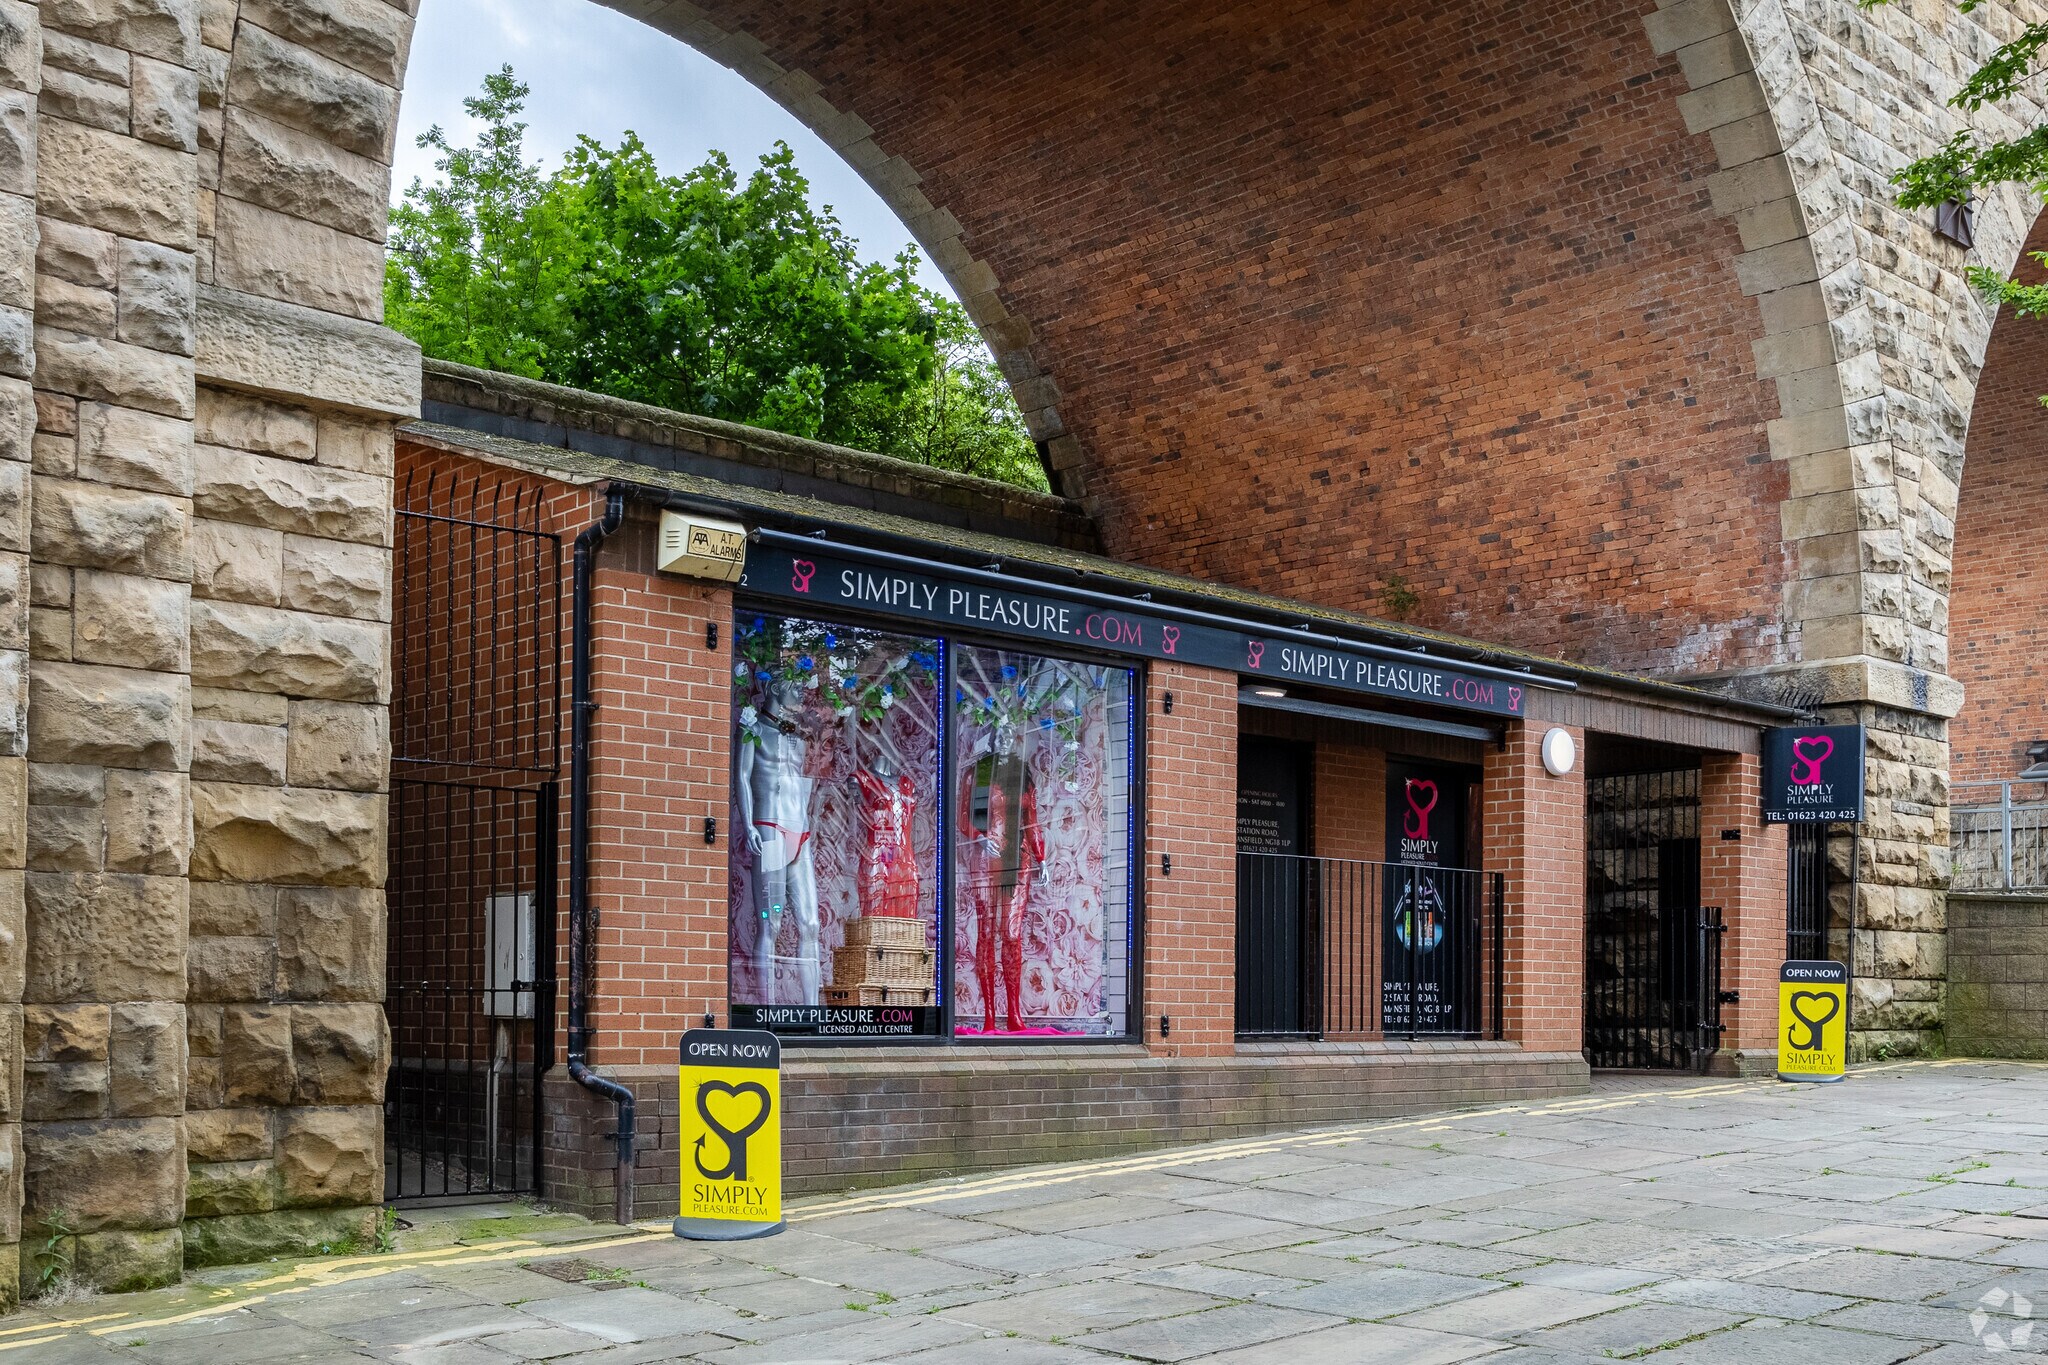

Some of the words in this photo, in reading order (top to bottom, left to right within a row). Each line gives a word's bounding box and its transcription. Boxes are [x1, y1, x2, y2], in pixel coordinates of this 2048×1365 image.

[720, 532, 734, 545] A.T.
[710, 544, 741, 559] ALARMS
[741, 574, 748, 586] 2
[841, 570, 939, 611] SIMPLY
[1281, 648, 1350, 681] SIMPLY
[1787, 783, 1834, 796] SIMPLY
[1787, 795, 1834, 805] PLEASURE
[1766, 811, 1785, 820] TEL:
[1788, 811, 1816, 820] 01623
[1819, 810, 1836, 819] 420
[1838, 810, 1856, 819] 425
[1236, 827, 1260, 835] STATION
[1237, 836, 1264, 845] ANSFIELD,
[1400, 838, 1438, 854] SIMPLY
[1786, 968, 1812, 977] OPEN
[1814, 969, 1841, 978] NOW
[1424, 1004, 1440, 1013] NG8
[756, 1008, 804, 1023] SIMPLY
[818, 1025, 856, 1034] LICENSED
[857, 1025, 883, 1034] ADULT
[884, 1025, 913, 1034] CENTRE
[689, 1042, 728, 1057] OPEN
[732, 1044, 771, 1058] NOW
[1786, 1052, 1836, 1065] SIMPLY
[1786, 1064, 1836, 1072] PLEASURE.COM
[693, 1183, 767, 1205] SIMPLY
[693, 1204, 768, 1216] PLEASURE.COM
